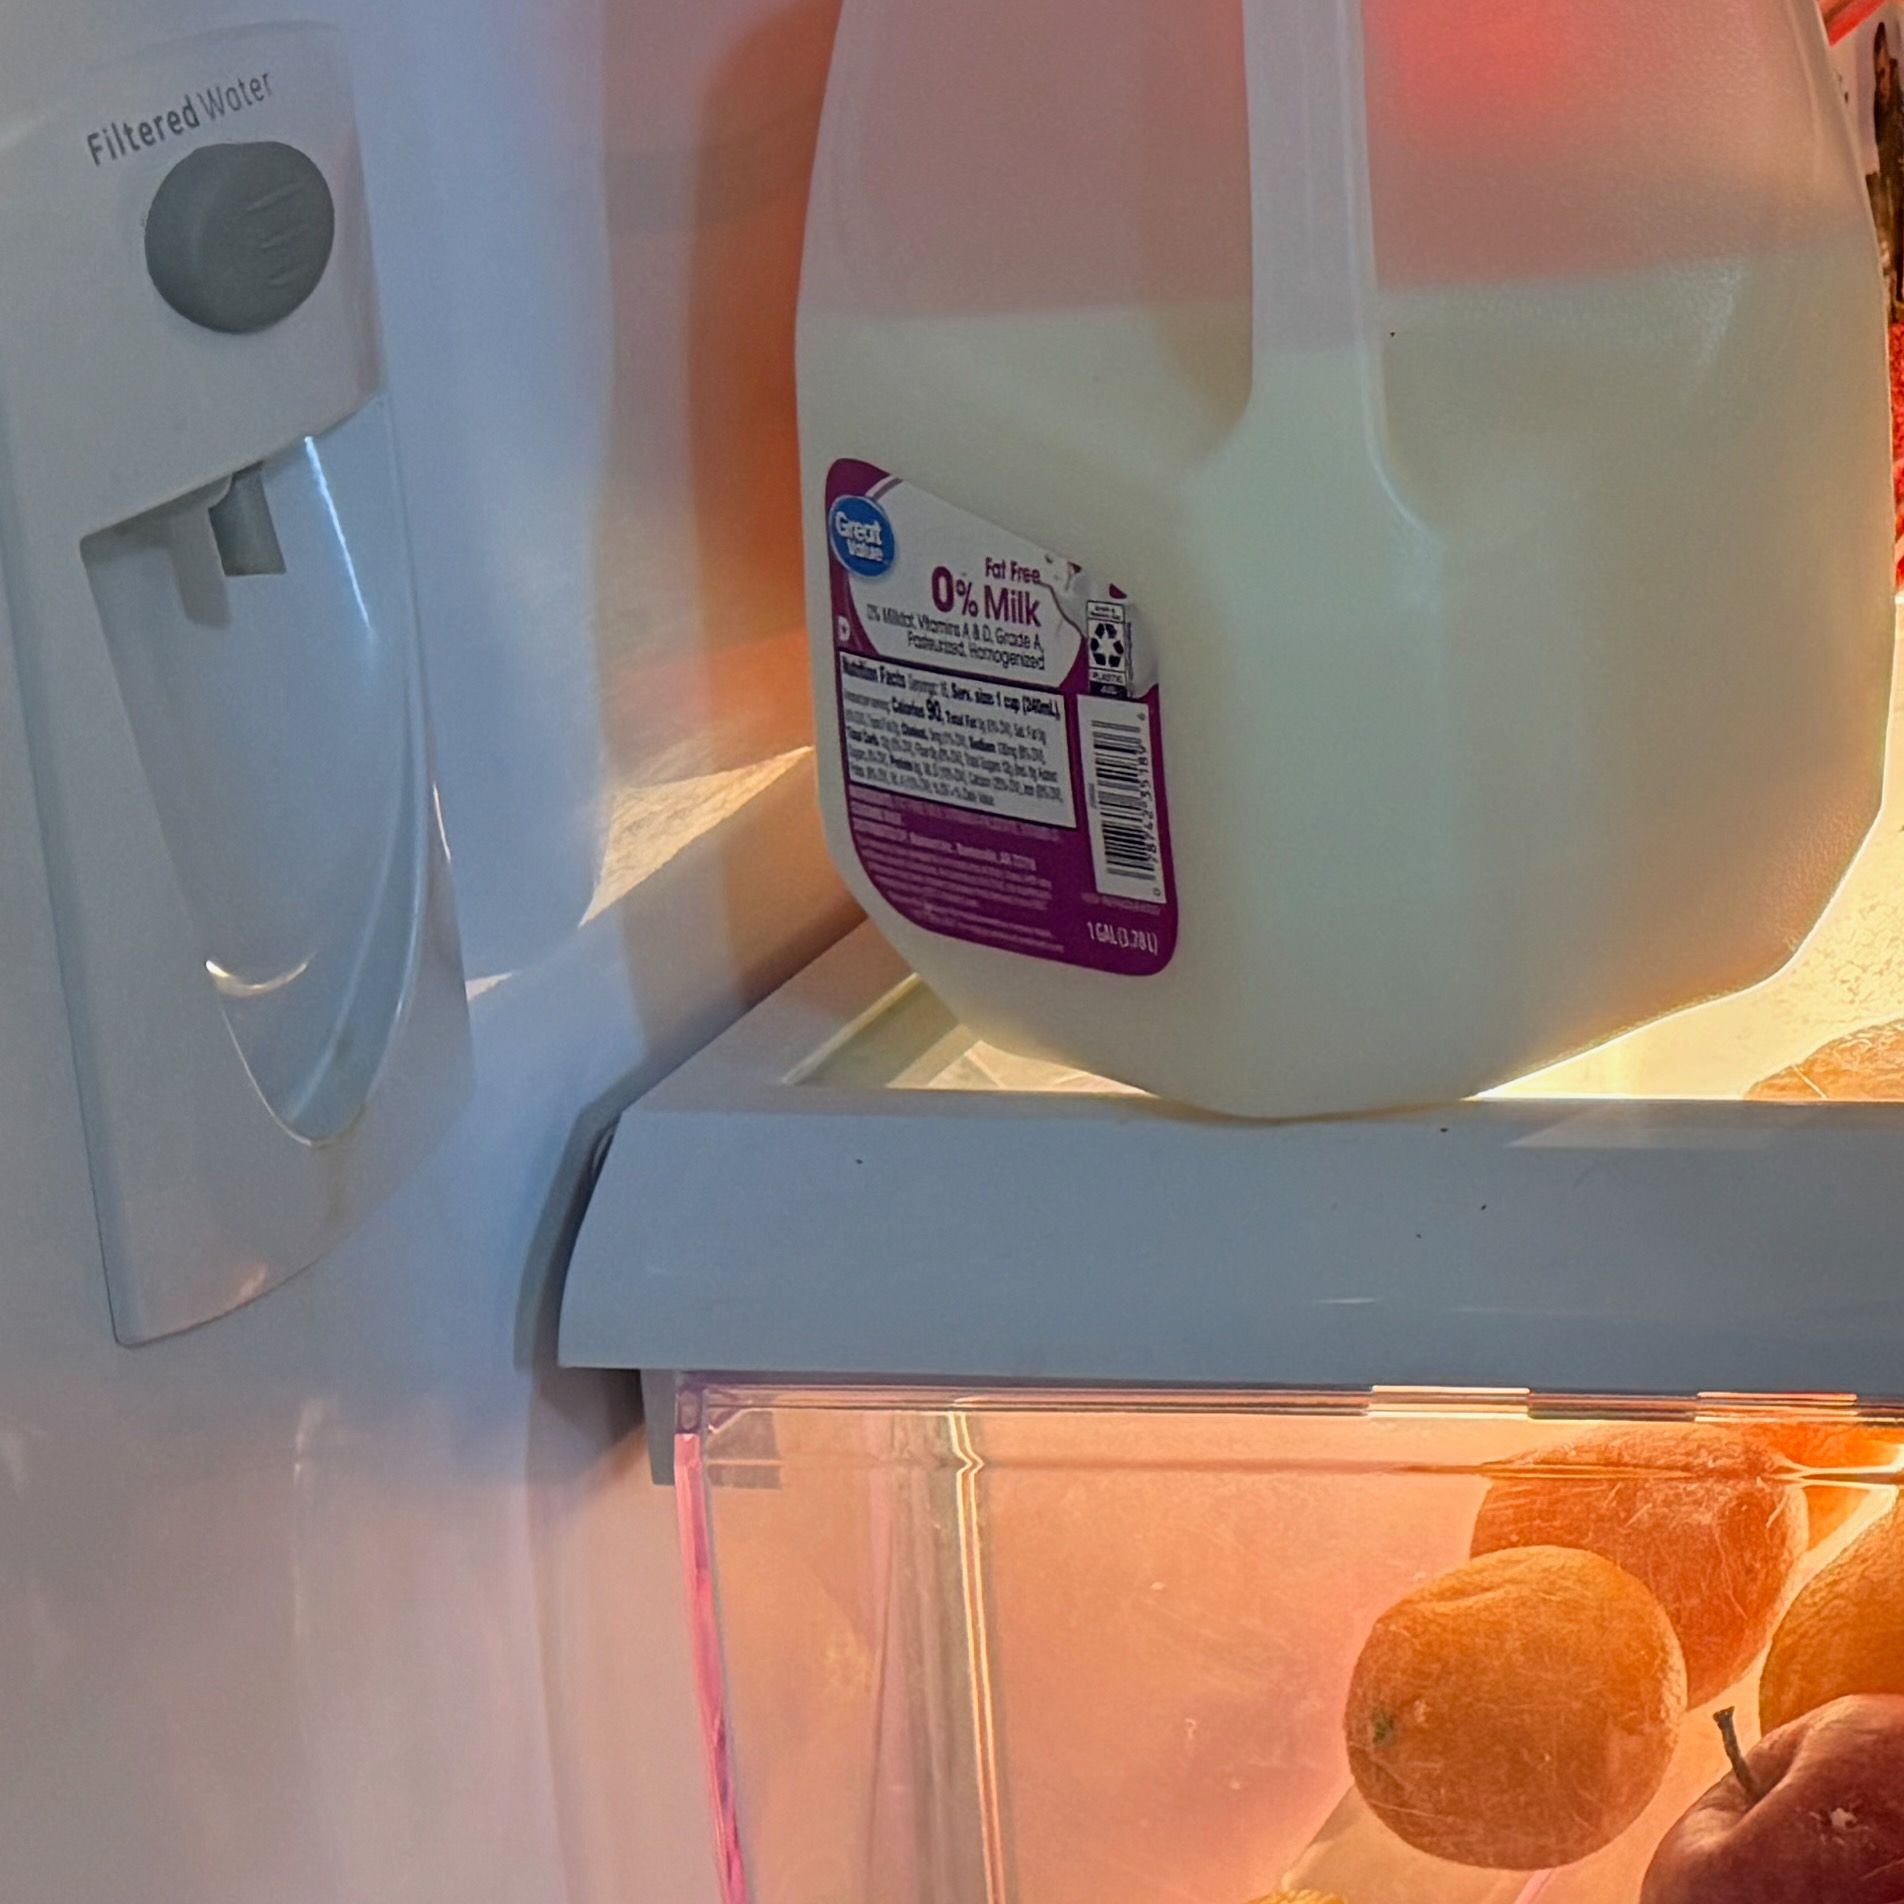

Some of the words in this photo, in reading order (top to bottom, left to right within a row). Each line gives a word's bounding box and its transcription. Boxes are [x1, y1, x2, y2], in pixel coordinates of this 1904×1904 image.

[87, 95, 200, 167] Filtered
[197, 71, 273, 121] Water
[835, 511, 882, 545] Great
[848, 539, 883, 561] Value
[985, 558, 1006, 580] Fat
[1010, 561, 1040, 584] Free
[932, 566, 978, 617] 0%
[984, 585, 1041, 627] Milk
[918, 614, 960, 637] Vitamins
[963, 623, 970, 635] A
[995, 628, 1030, 649] Grade
[969, 643, 1045, 670] Homogenized
[1096, 922, 1118, 944] GAL
